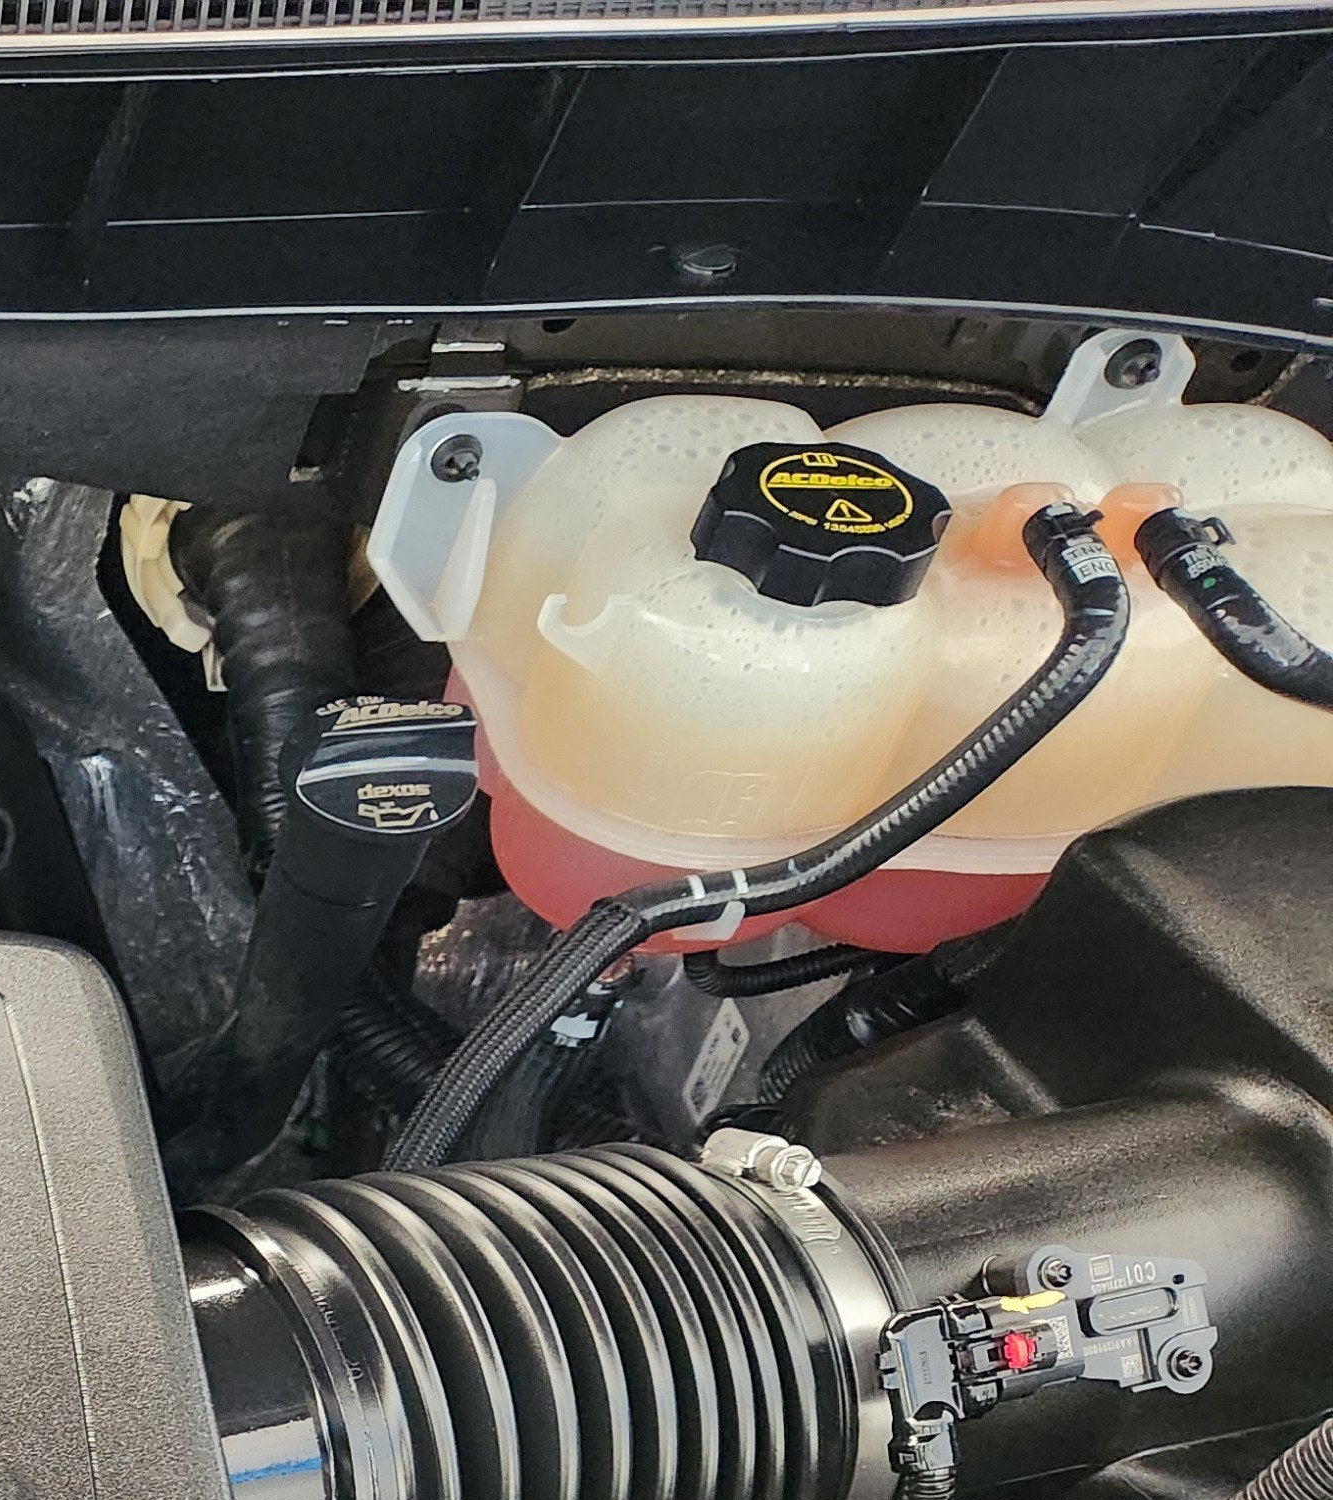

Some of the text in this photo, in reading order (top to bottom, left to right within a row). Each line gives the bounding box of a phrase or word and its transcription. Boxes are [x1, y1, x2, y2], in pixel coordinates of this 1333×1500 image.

[769, 472, 894, 488] ACDelco
[335, 700, 463, 725] ACDelco
[357, 783, 432, 800] dexos
[1125, 1261, 1156, 1286] C01
